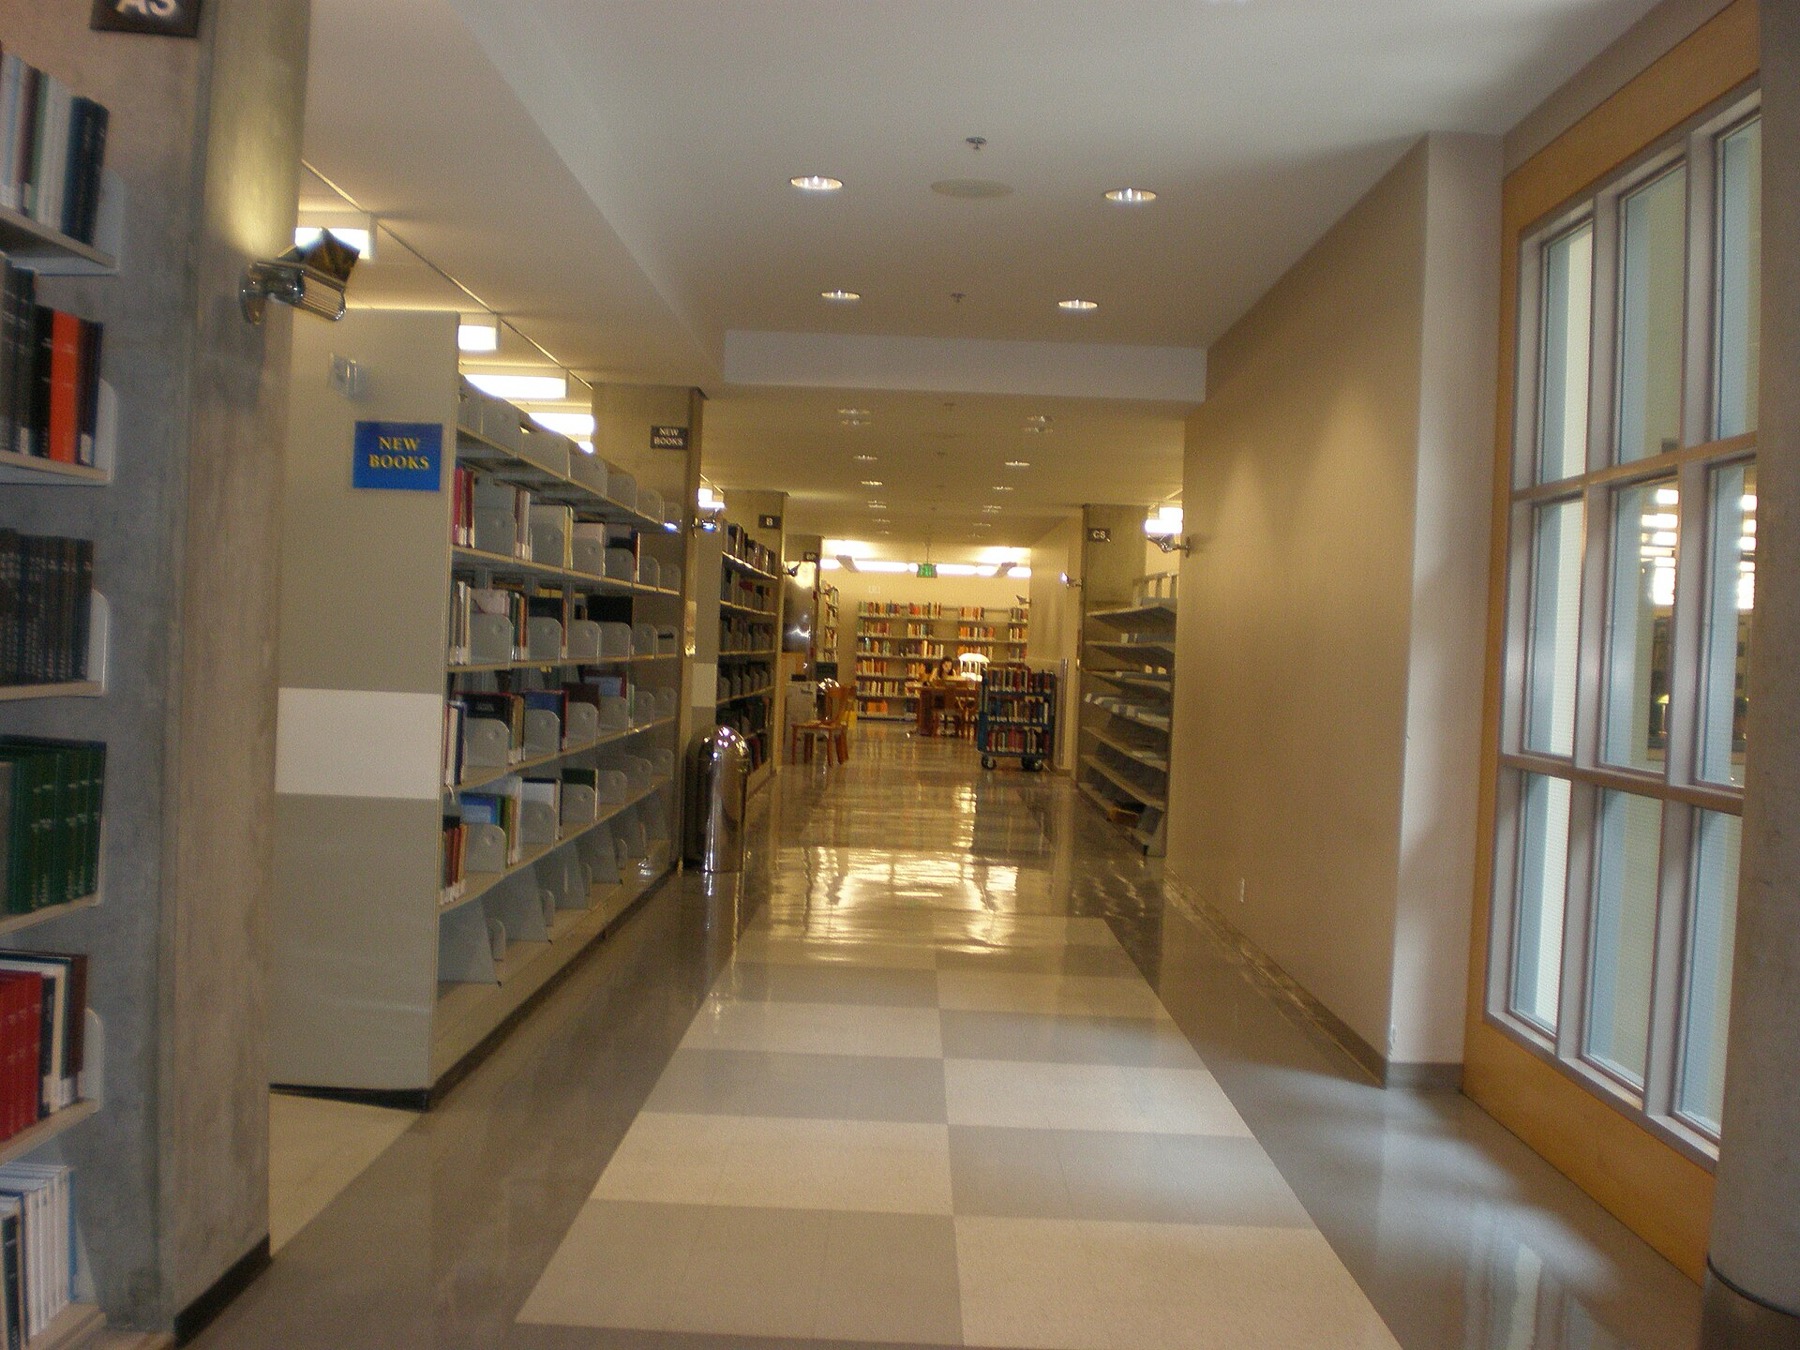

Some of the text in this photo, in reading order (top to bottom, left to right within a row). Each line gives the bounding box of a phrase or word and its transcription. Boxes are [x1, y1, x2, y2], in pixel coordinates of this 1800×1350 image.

[659, 427, 679, 436] NEW
[378, 436, 419, 451] NEW
[653, 436, 684, 446] BOOKS
[368, 454, 430, 469] BOOKS
